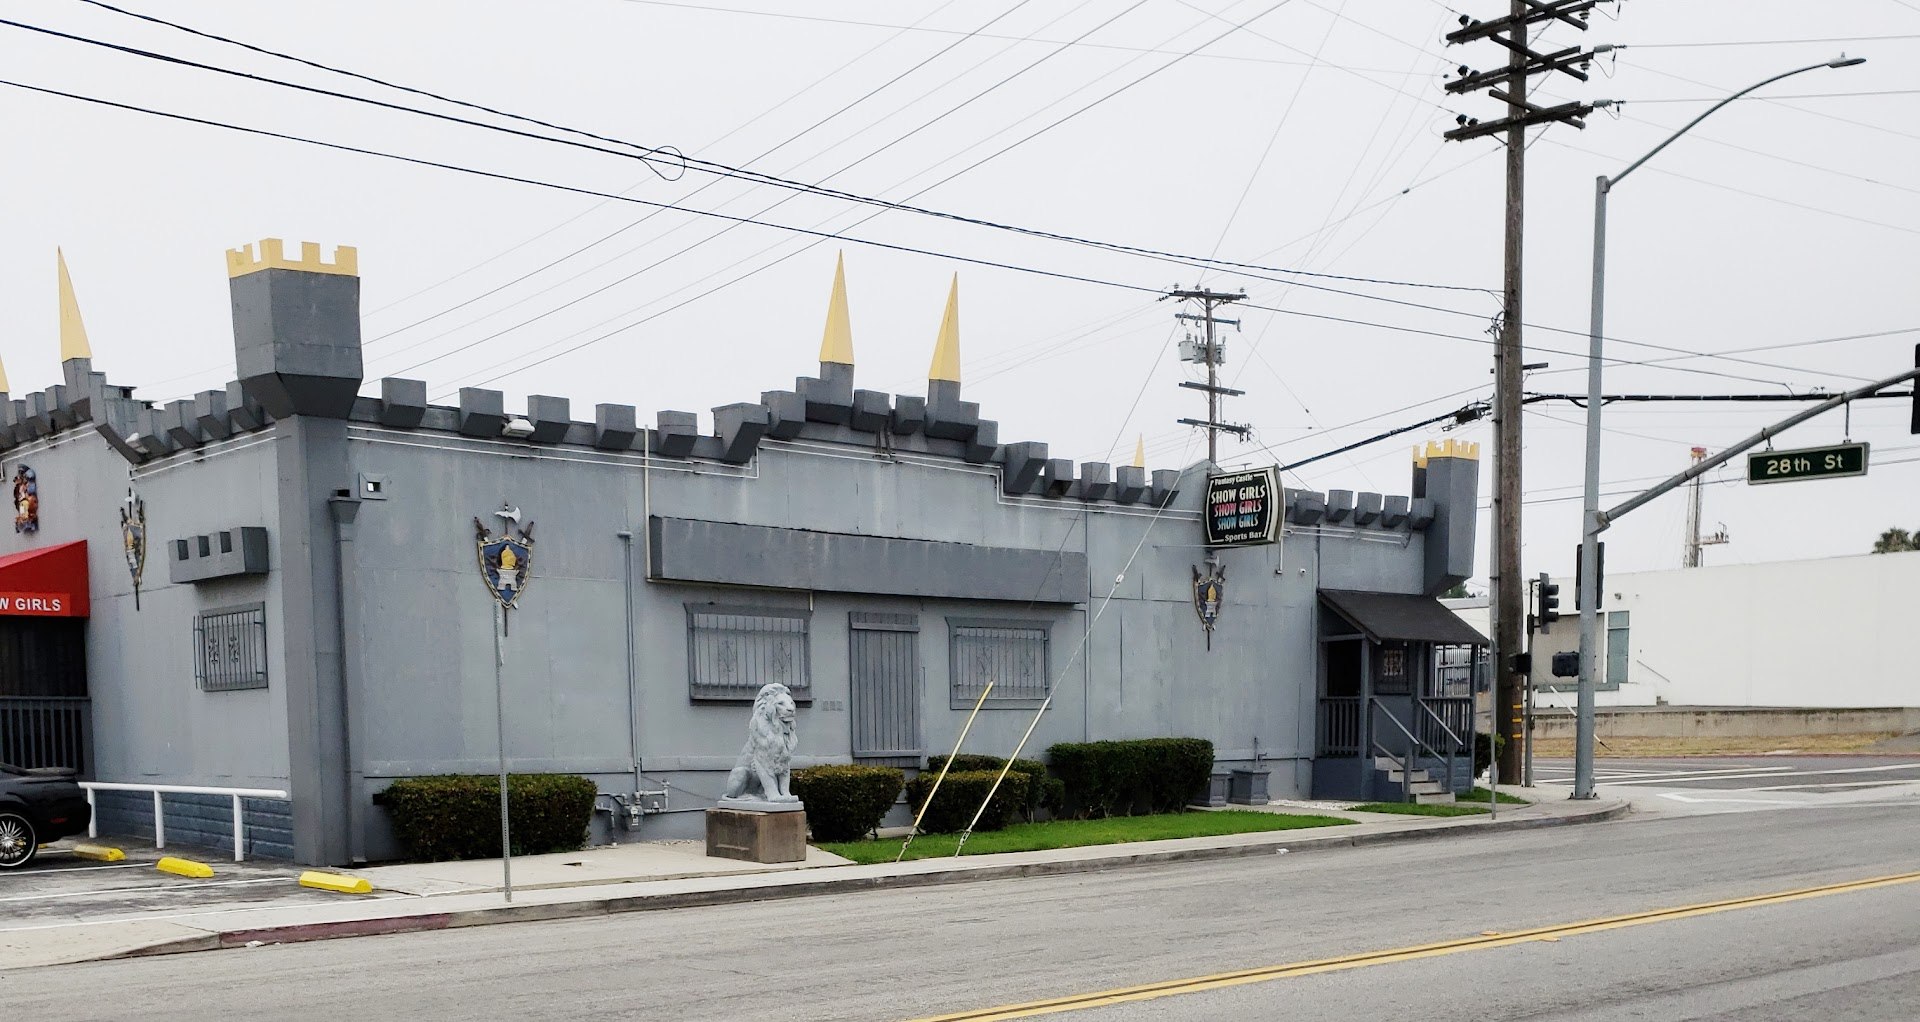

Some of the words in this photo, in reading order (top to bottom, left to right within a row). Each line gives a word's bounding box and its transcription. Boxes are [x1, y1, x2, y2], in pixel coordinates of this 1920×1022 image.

[1767, 458, 1810, 475] 28th
[1824, 454, 1843, 469] St
[1215, 477, 1235, 486] Fantasy
[1236, 474, 1253, 483] Castle
[1211, 489, 1236, 504] SHOW
[1239, 485, 1265, 500] GIRLS
[1214, 503, 1236, 517] SHOW
[1239, 500, 1262, 514] GIRLS
[1217, 517, 1236, 530] SHOW
[1239, 514, 1258, 528] GIRLS
[1225, 533, 1247, 542] Sports
[1249, 531, 1262, 539] Bar
[15, 598, 61, 611] GIRLS
